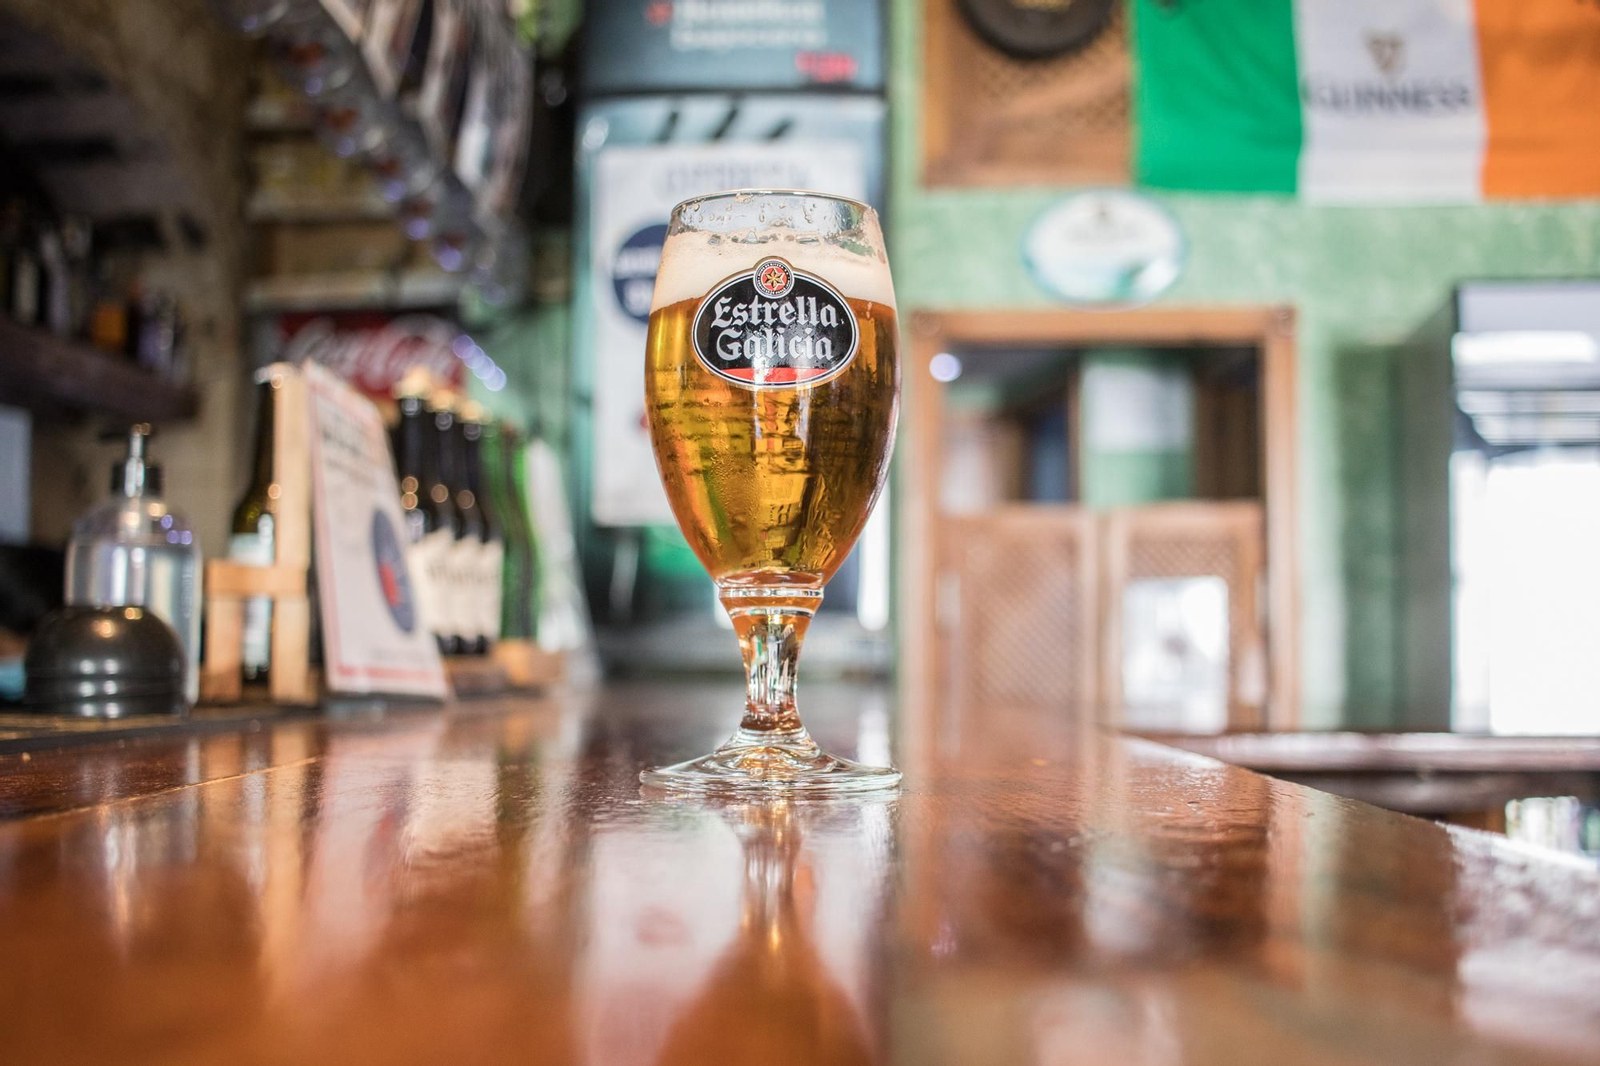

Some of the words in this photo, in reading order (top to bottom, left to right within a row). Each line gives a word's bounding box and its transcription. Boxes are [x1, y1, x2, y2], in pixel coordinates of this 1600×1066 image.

[1304, 80, 1472, 114] GUINNESS
[710, 294, 839, 329] Estrella
[716, 327, 834, 361] Galicia
